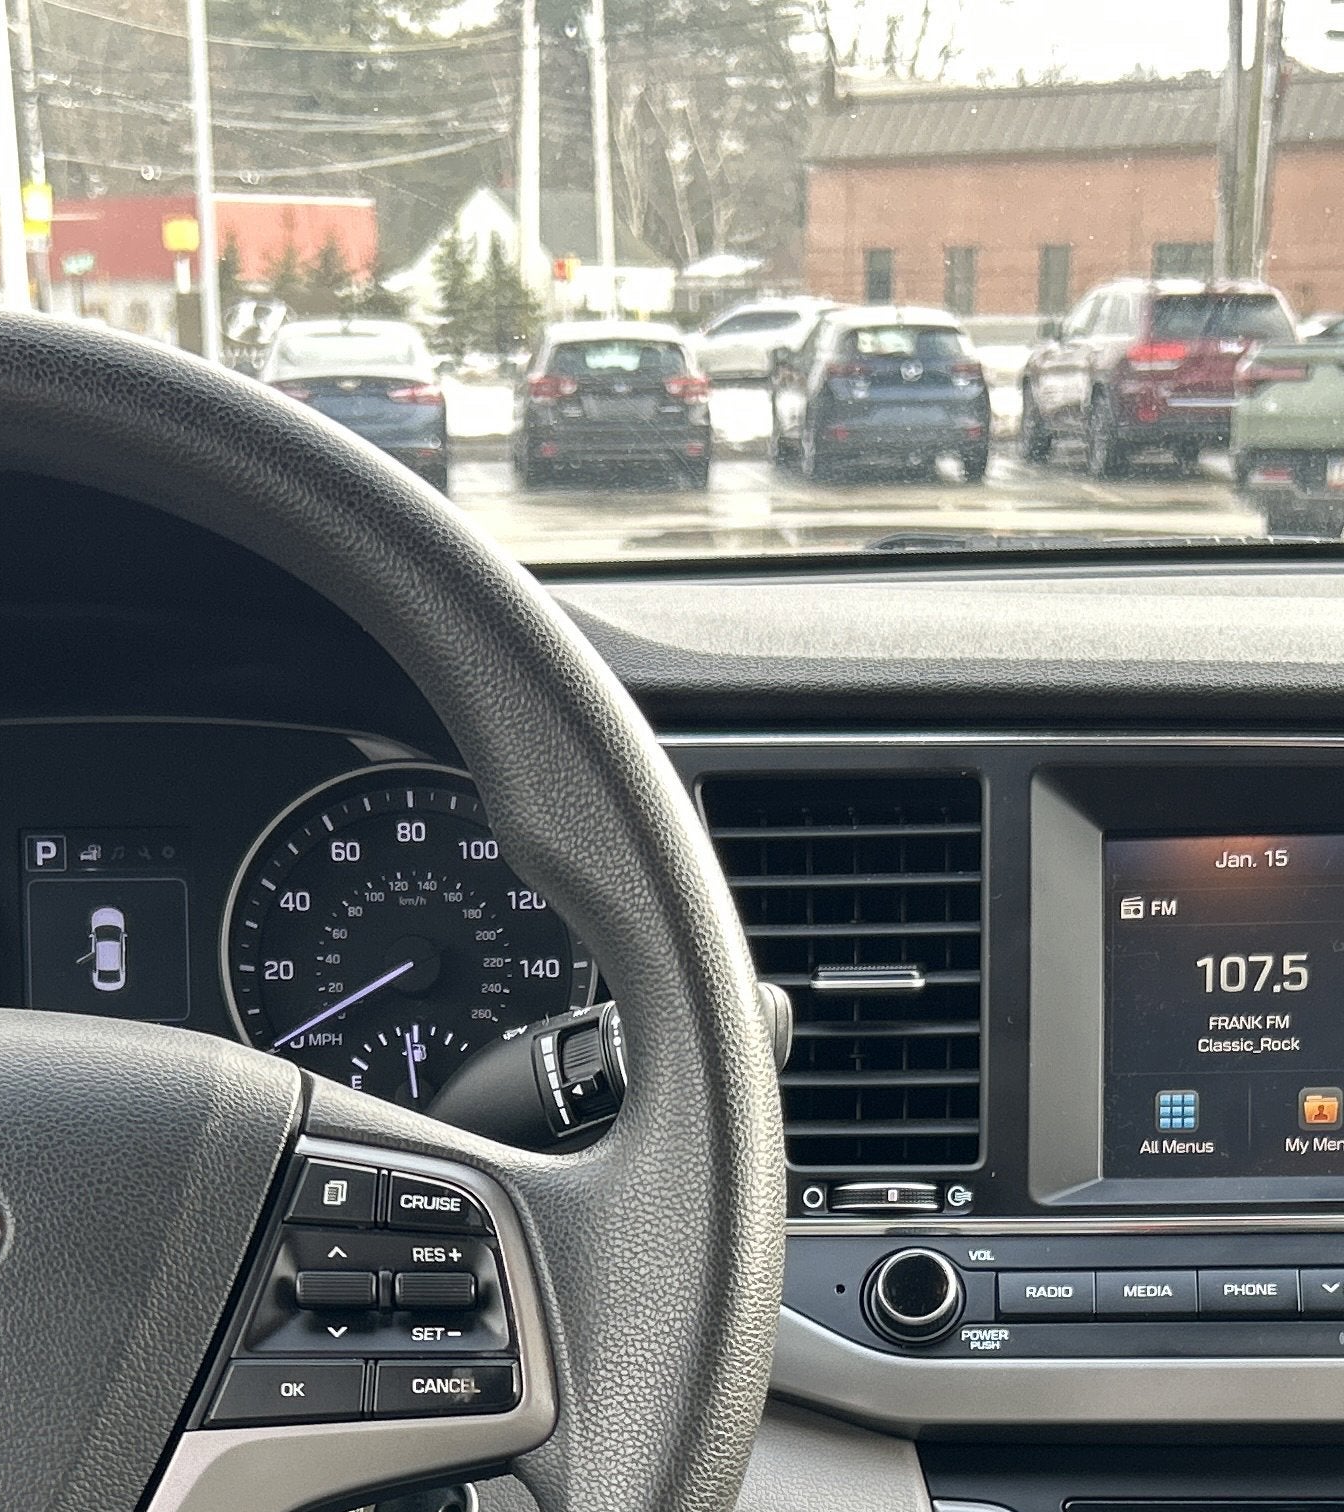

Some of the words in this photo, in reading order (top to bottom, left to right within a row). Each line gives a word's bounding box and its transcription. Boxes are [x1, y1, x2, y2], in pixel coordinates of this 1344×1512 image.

[396, 821, 426, 842] 80
[36, 841, 57, 866] P
[331, 841, 361, 862] 60
[458, 840, 499, 860] 100
[1215, 850, 1257, 869] Jan.
[1263, 849, 1288, 867] 15
[388, 880, 409, 892] 120
[417, 880, 438, 891] 140
[279, 891, 311, 912] 40
[364, 891, 385, 902] 100
[398, 895, 427, 907] km/h
[442, 891, 463, 903] 160
[347, 905, 363, 917] 80
[462, 908, 482, 919] 180
[1151, 899, 1177, 916] FM
[332, 928, 348, 940] 60
[475, 930, 497, 941] 200
[324, 953, 341, 965] 40
[483, 957, 504, 968] 220
[264, 960, 294, 980] 20
[519, 958, 560, 979] 140
[1196, 953, 1309, 993] 107.5
[328, 982, 344, 993] 20
[481, 982, 502, 994] 240
[471, 1008, 492, 1019] 260
[1208, 1015, 1263, 1031] FRANK
[1266, 1014, 1290, 1030] FM
[308, 1032, 343, 1046] MPH
[1197, 1036, 1300, 1054] Classic_Rock
[1139, 1139, 1160, 1154] All
[1163, 1139, 1214, 1154] Menus
[1285, 1137, 1310, 1155] My
[399, 1194, 462, 1212] CRUISE
[968, 1249, 995, 1261] VOL
[1025, 1285, 1074, 1298] RADIO
[1123, 1283, 1173, 1298] MEDIA
[1223, 1282, 1278, 1296] PHONE
[961, 1328, 1010, 1341] POWER
[969, 1340, 1001, 1350] PUSH
[280, 1382, 306, 1397] OK
[411, 1377, 481, 1395] CANCEL
